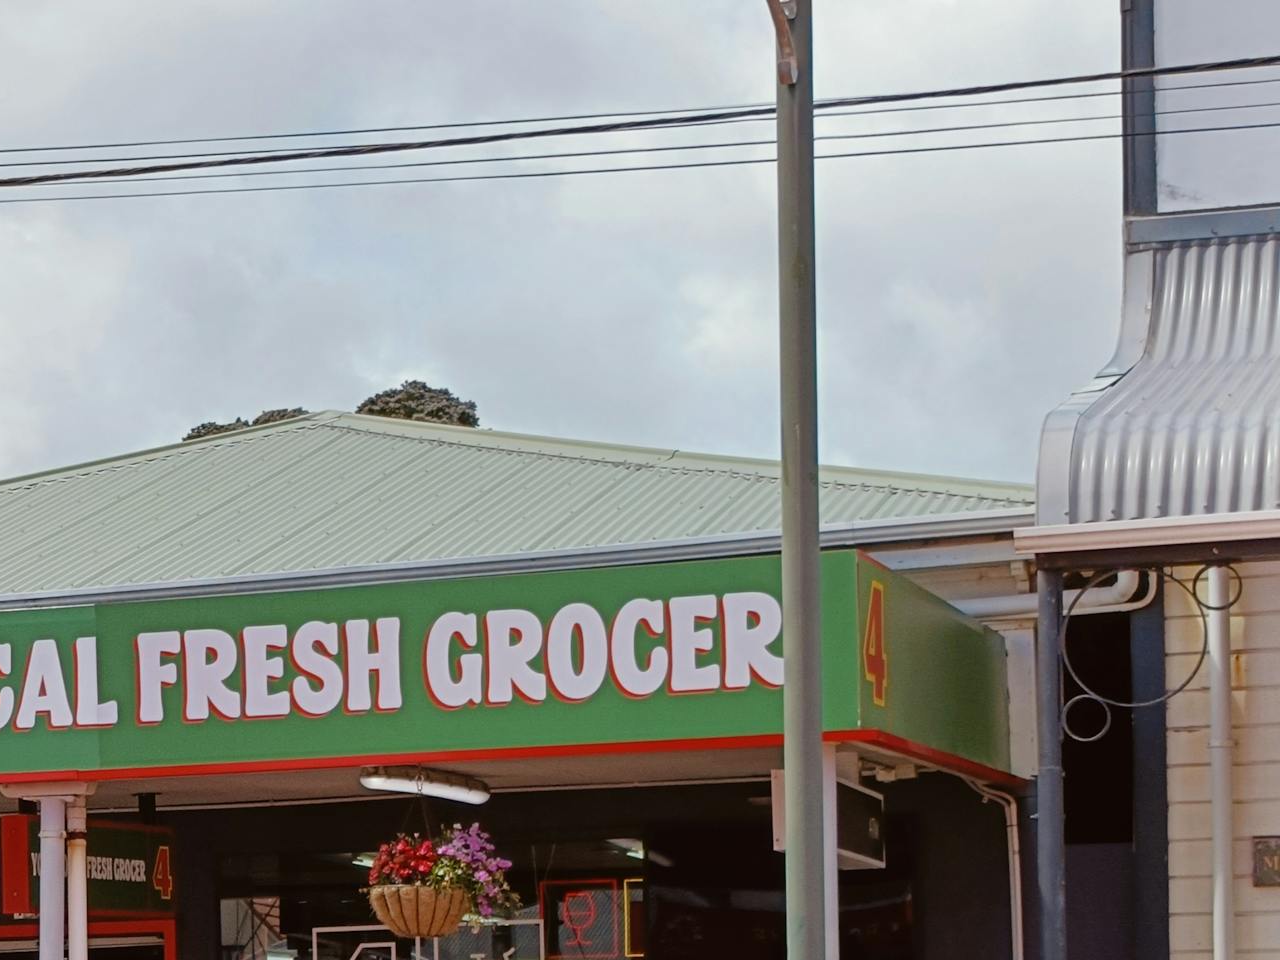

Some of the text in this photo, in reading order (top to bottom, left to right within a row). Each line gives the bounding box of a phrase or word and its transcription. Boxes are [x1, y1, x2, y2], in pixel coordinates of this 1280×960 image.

[134, 616, 402, 724] FRESH
[423, 592, 784, 709] GROCER
[863, 580, 888, 707] 4
[86, 856, 112, 880] FRESH
[113, 858, 146, 882] GROCER
[152, 845, 173, 900] 4
